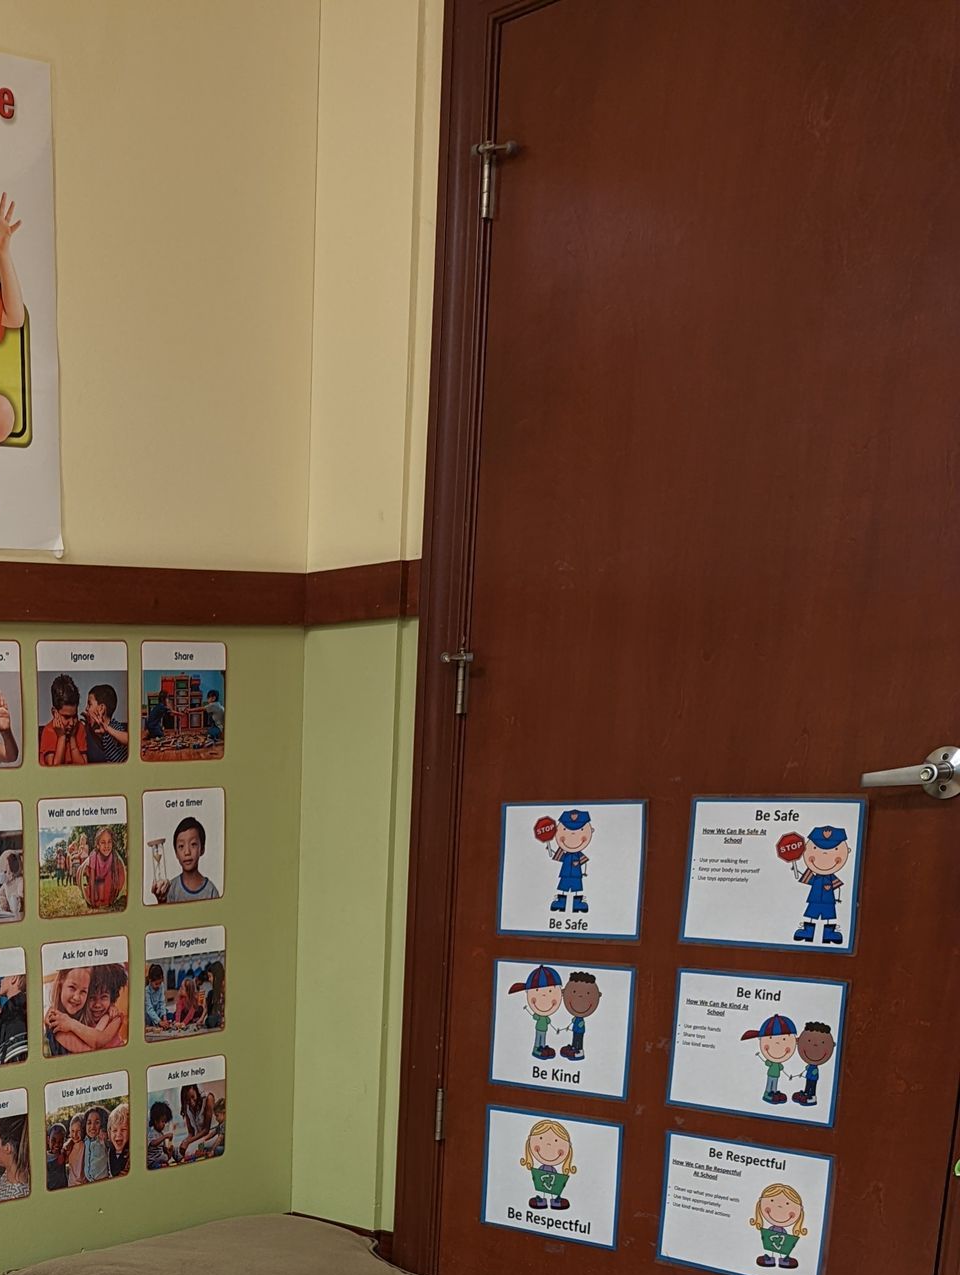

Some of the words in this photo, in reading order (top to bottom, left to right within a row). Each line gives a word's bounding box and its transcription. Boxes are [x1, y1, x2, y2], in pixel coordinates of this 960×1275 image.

[70, 651, 95, 662] Ignore
[174, 651, 194, 661] Share
[165, 799, 177, 809] Get
[179, 800, 185, 808] a
[186, 798, 203, 807] timer
[48, 807, 64, 818] Wait
[65, 807, 81, 817] and
[82, 806, 99, 816] take
[100, 806, 117, 815] turns
[755, 810, 770, 821] Be
[773, 809, 800, 822] Safe
[536, 824, 555, 835] STOP
[727, 828, 737, 836] Can
[723, 837, 742, 845] School
[780, 841, 803, 853] STOP
[720, 857, 738, 865] walking
[549, 918, 562, 929] Be
[565, 919, 588, 930] Safe
[164, 939, 177, 950] Play
[178, 936, 207, 949] together
[62, 949, 75, 960] Ask
[76, 949, 87, 959] for
[88, 950, 93, 958] a
[95, 947, 108, 960] hug
[737, 987, 751, 998] Be
[754, 989, 781, 1001] Kind
[707, 1009, 725, 1017] School
[167, 1070, 179, 1080] Ask
[180, 1069, 189, 1079] for
[190, 1067, 205, 1078] help
[532, 1066, 547, 1079] Be
[551, 1068, 580, 1084] Kind
[61, 1088, 74, 1098] Use
[75, 1085, 91, 1095] kind
[92, 1081, 112, 1093] words
[709, 1147, 723, 1159] Be
[726, 1150, 786, 1171] Respectful
[685, 1160, 694, 1168] We
[695, 1162, 705, 1170] Can
[714, 1166, 742, 1177] Respectful
[700, 1172, 718, 1180] School
[692, 1197, 721, 1208] appropriately
[714, 1209, 731, 1217] actions
[507, 1207, 522, 1220] Be
[526, 1210, 591, 1235] Respectful
